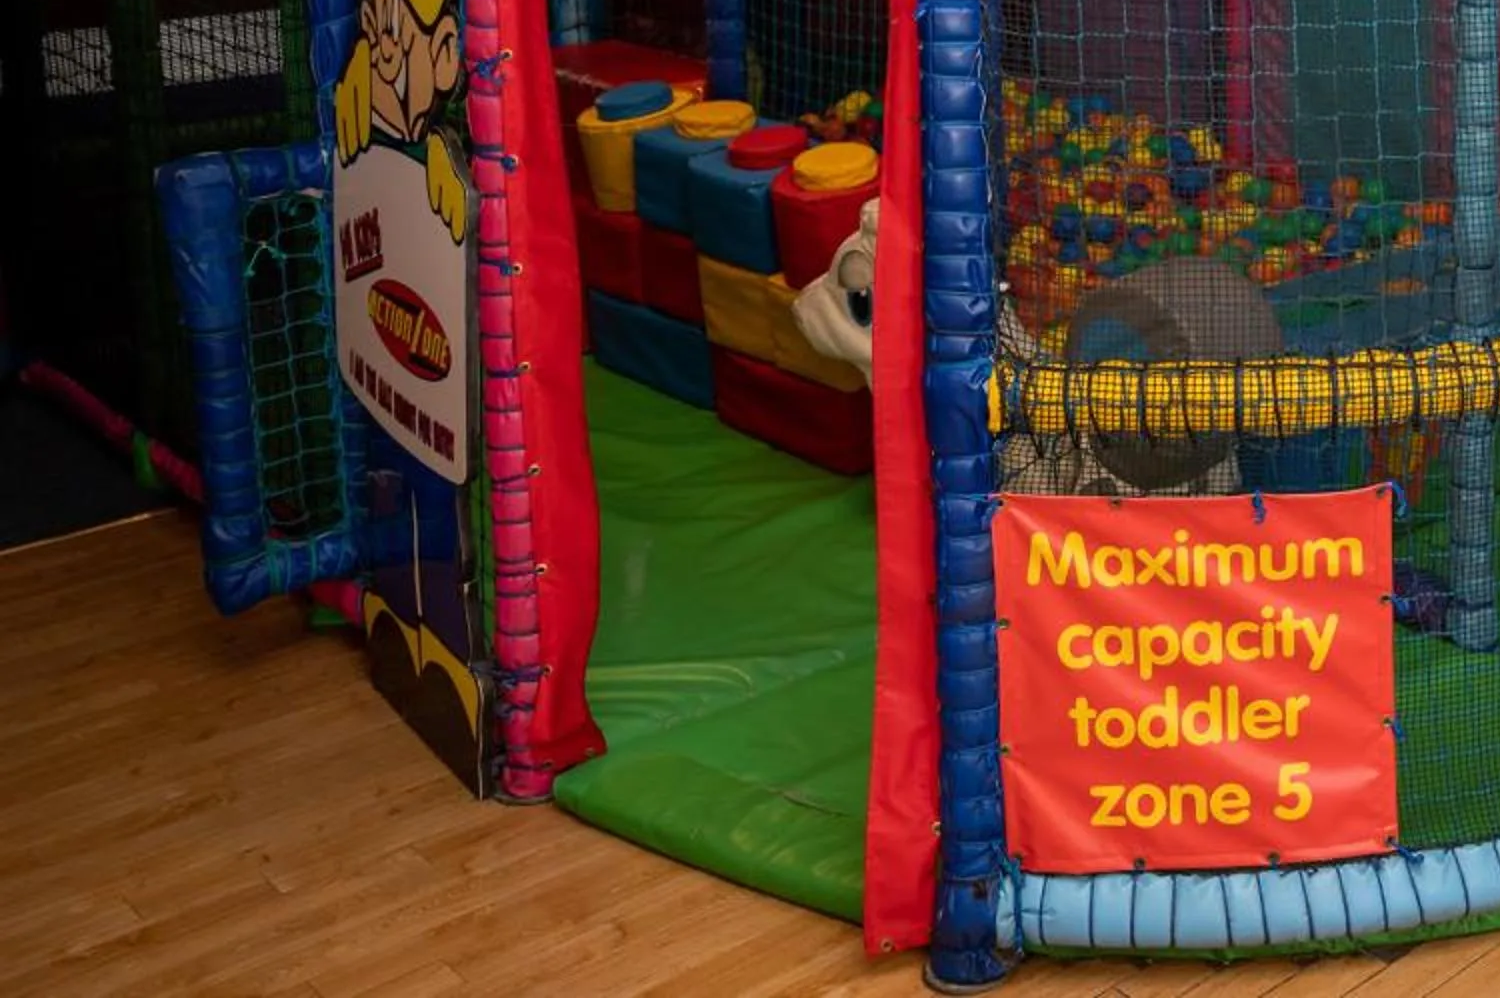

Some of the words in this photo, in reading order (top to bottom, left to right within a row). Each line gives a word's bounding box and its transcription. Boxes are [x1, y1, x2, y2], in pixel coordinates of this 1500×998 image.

[1026, 529, 1364, 588] Maximum
[1057, 605, 1339, 680] capacity
[1068, 685, 1311, 749] toddler
[1089, 780, 1251, 828] zone
[1273, 761, 1313, 821] 5
